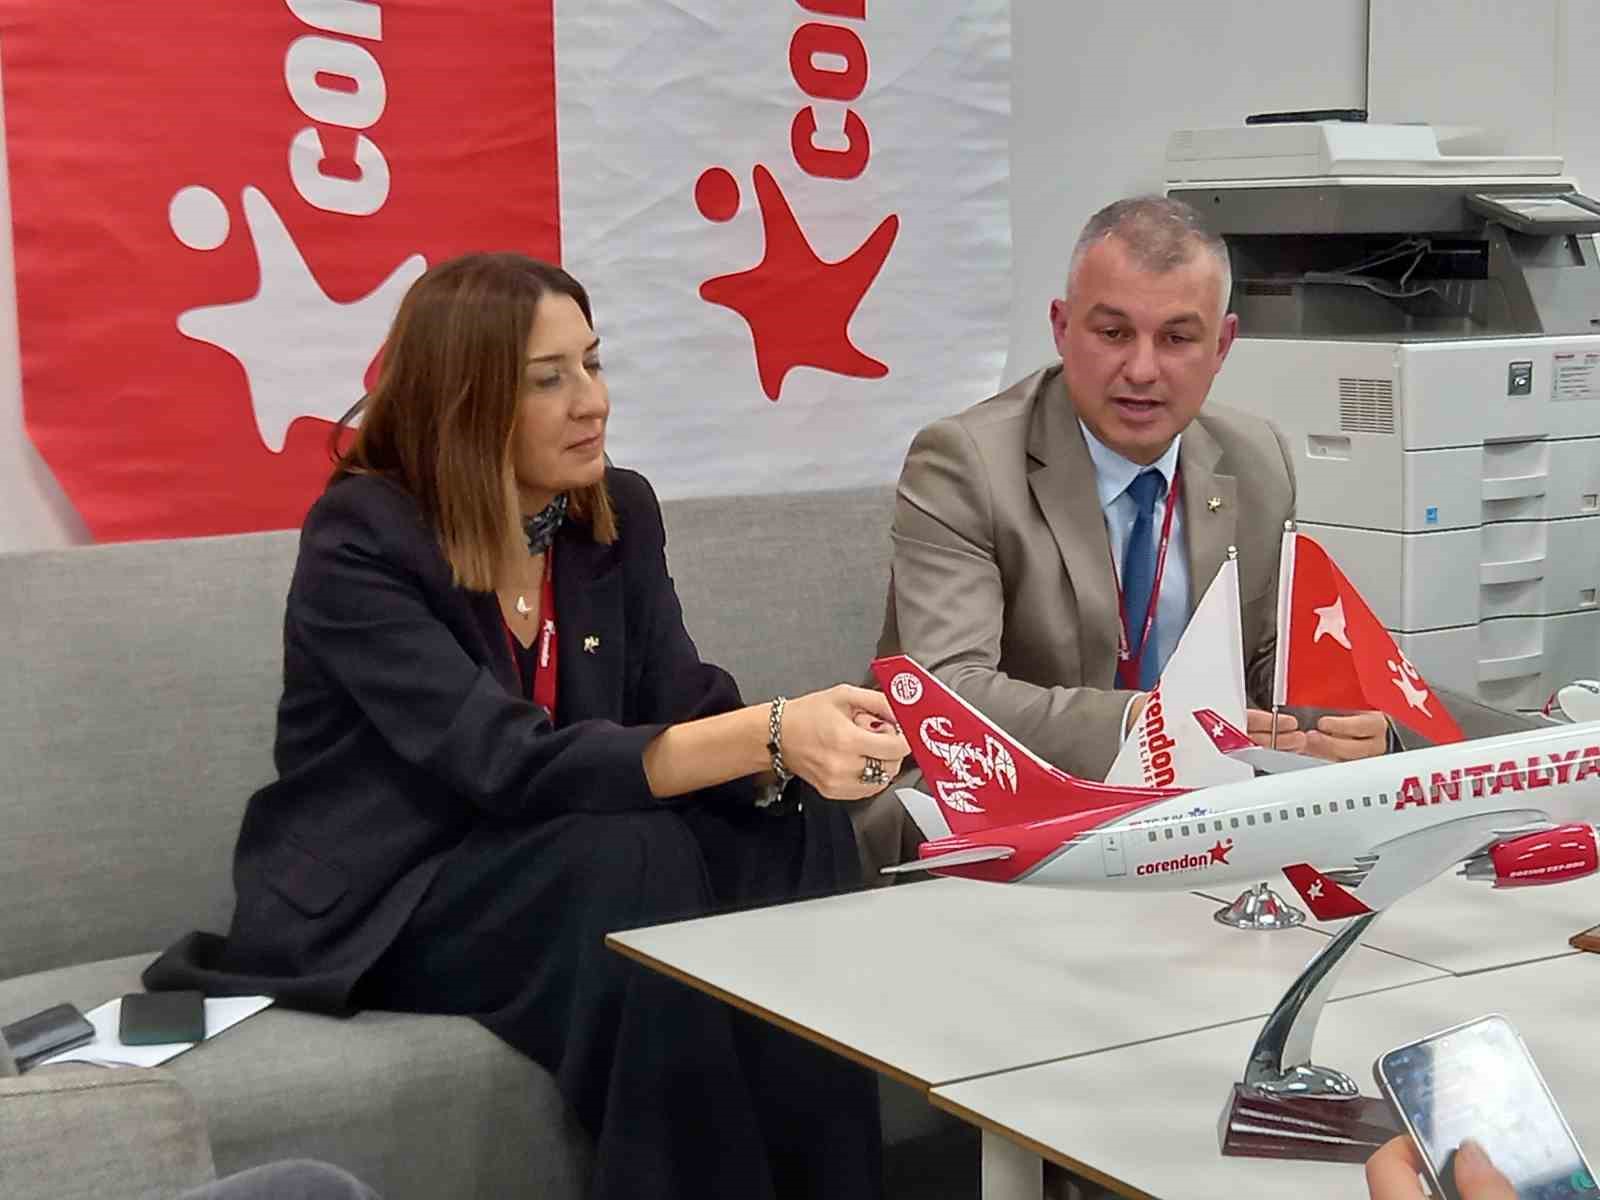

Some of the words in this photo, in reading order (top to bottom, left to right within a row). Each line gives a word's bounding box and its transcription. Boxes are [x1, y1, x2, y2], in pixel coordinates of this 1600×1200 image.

[1139, 726, 1154, 788] AIRLINE
[1145, 683, 1175, 787] rendon
[1394, 746, 1600, 811] ANTALYA
[1137, 854, 1207, 876] corendon
